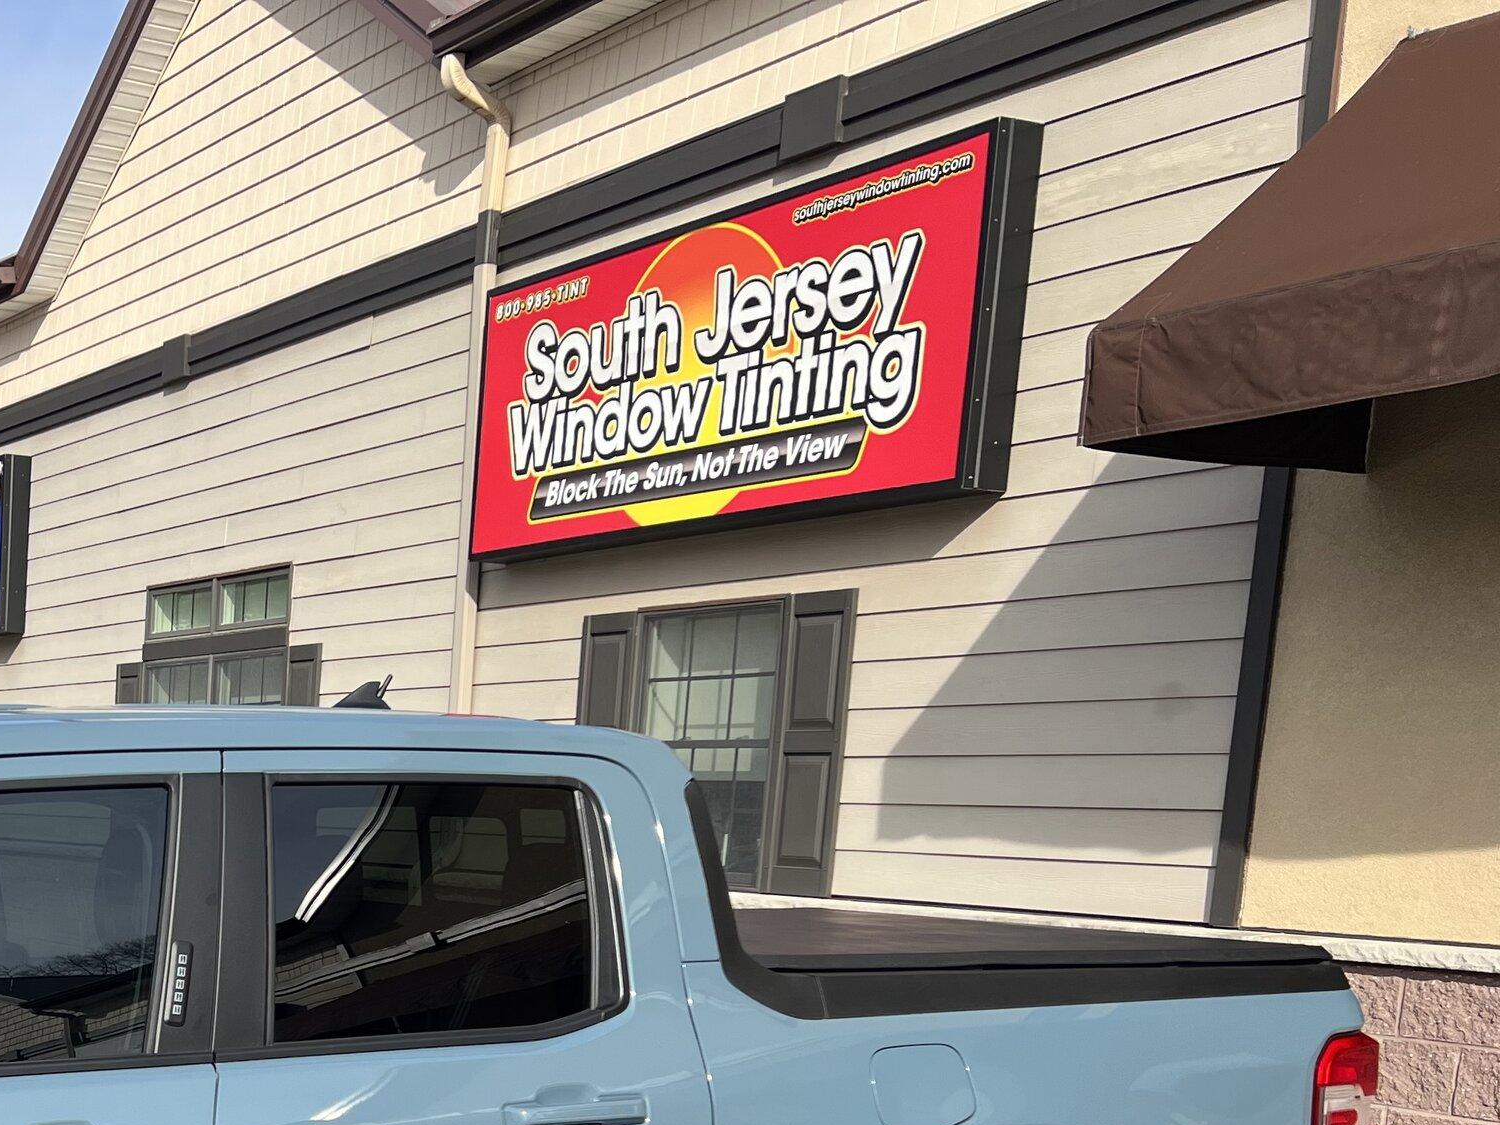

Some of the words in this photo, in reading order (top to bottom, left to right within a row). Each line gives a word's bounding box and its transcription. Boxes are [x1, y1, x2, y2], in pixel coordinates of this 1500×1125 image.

[793, 154, 972, 222] southjerseywindowtinting.com
[525, 291, 682, 399] South
[694, 231, 924, 361] Jersey
[510, 376, 712, 477] Window
[716, 326, 922, 430] Tinting
[545, 474, 604, 507] Block
[603, 471, 638, 498] The
[643, 462, 687, 490] Sun,
[691, 454, 735, 483] Not
[738, 445, 779, 474] The
[786, 433, 849, 467] View
